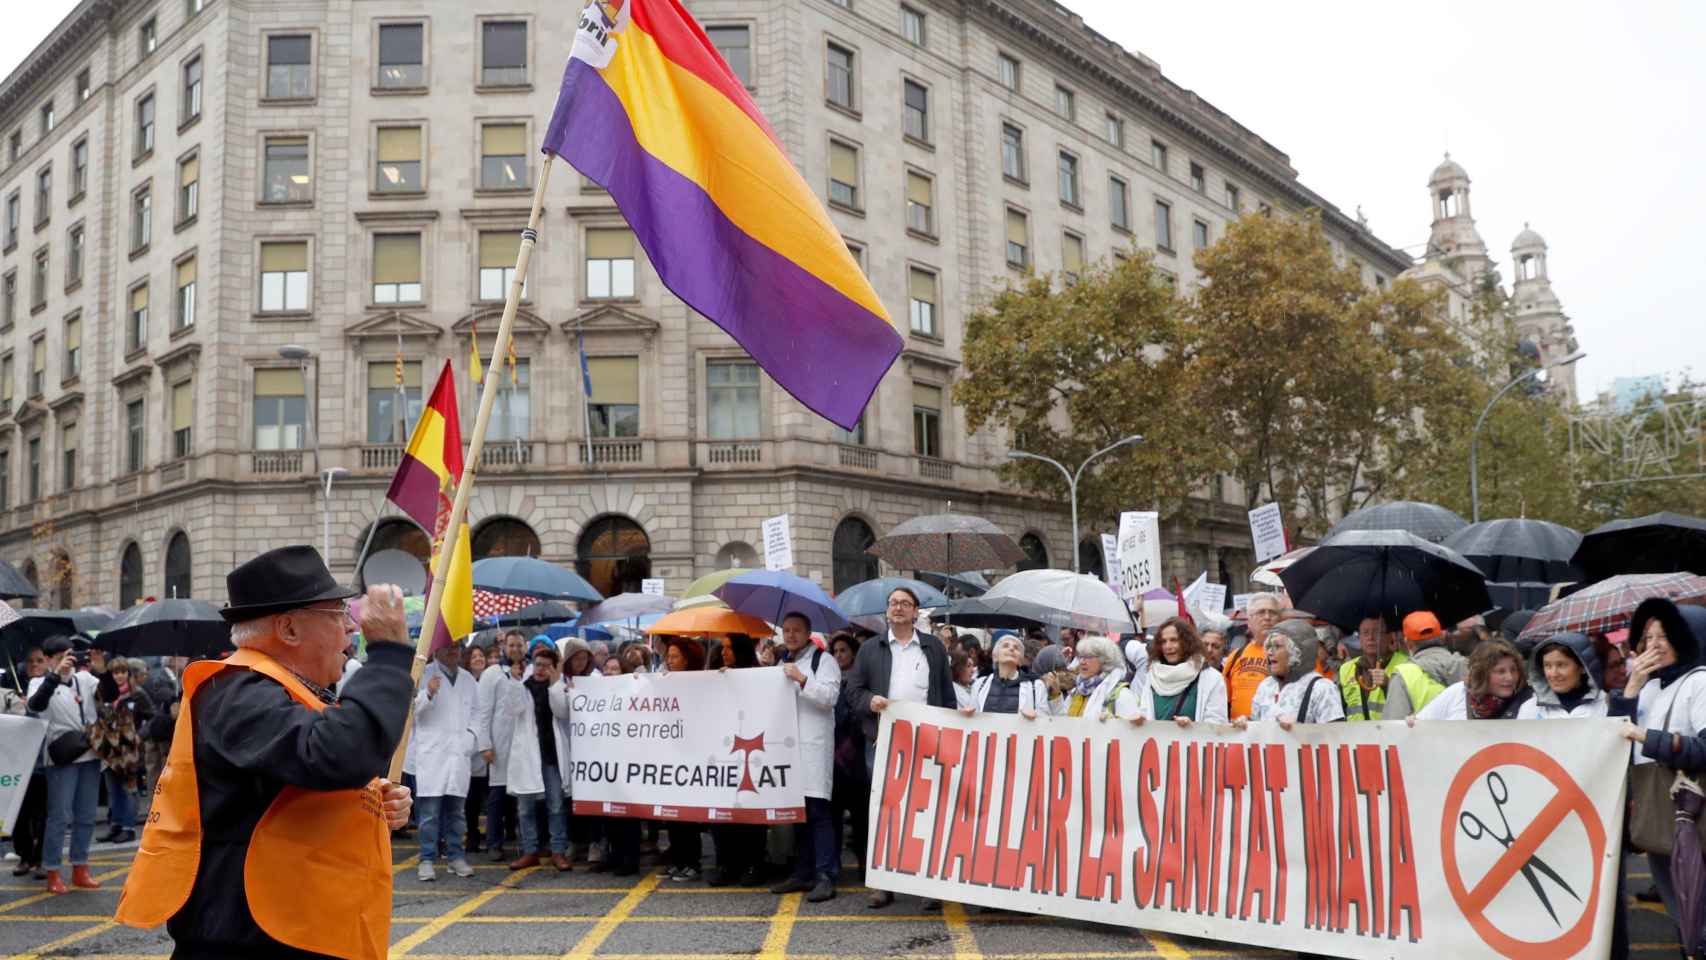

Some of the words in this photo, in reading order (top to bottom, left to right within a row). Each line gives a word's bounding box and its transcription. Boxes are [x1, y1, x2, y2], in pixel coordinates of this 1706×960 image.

[572, 694, 606, 712] Que
[609, 694, 622, 711] la
[628, 697, 681, 712] XARXA
[590, 722, 621, 737] ens
[627, 719, 684, 739] enredi
[872, 719, 1073, 897] RETALLAR
[1076, 737, 1124, 904] LA
[1133, 737, 1288, 925] SANITAT
[1299, 744, 1423, 943] MATA
